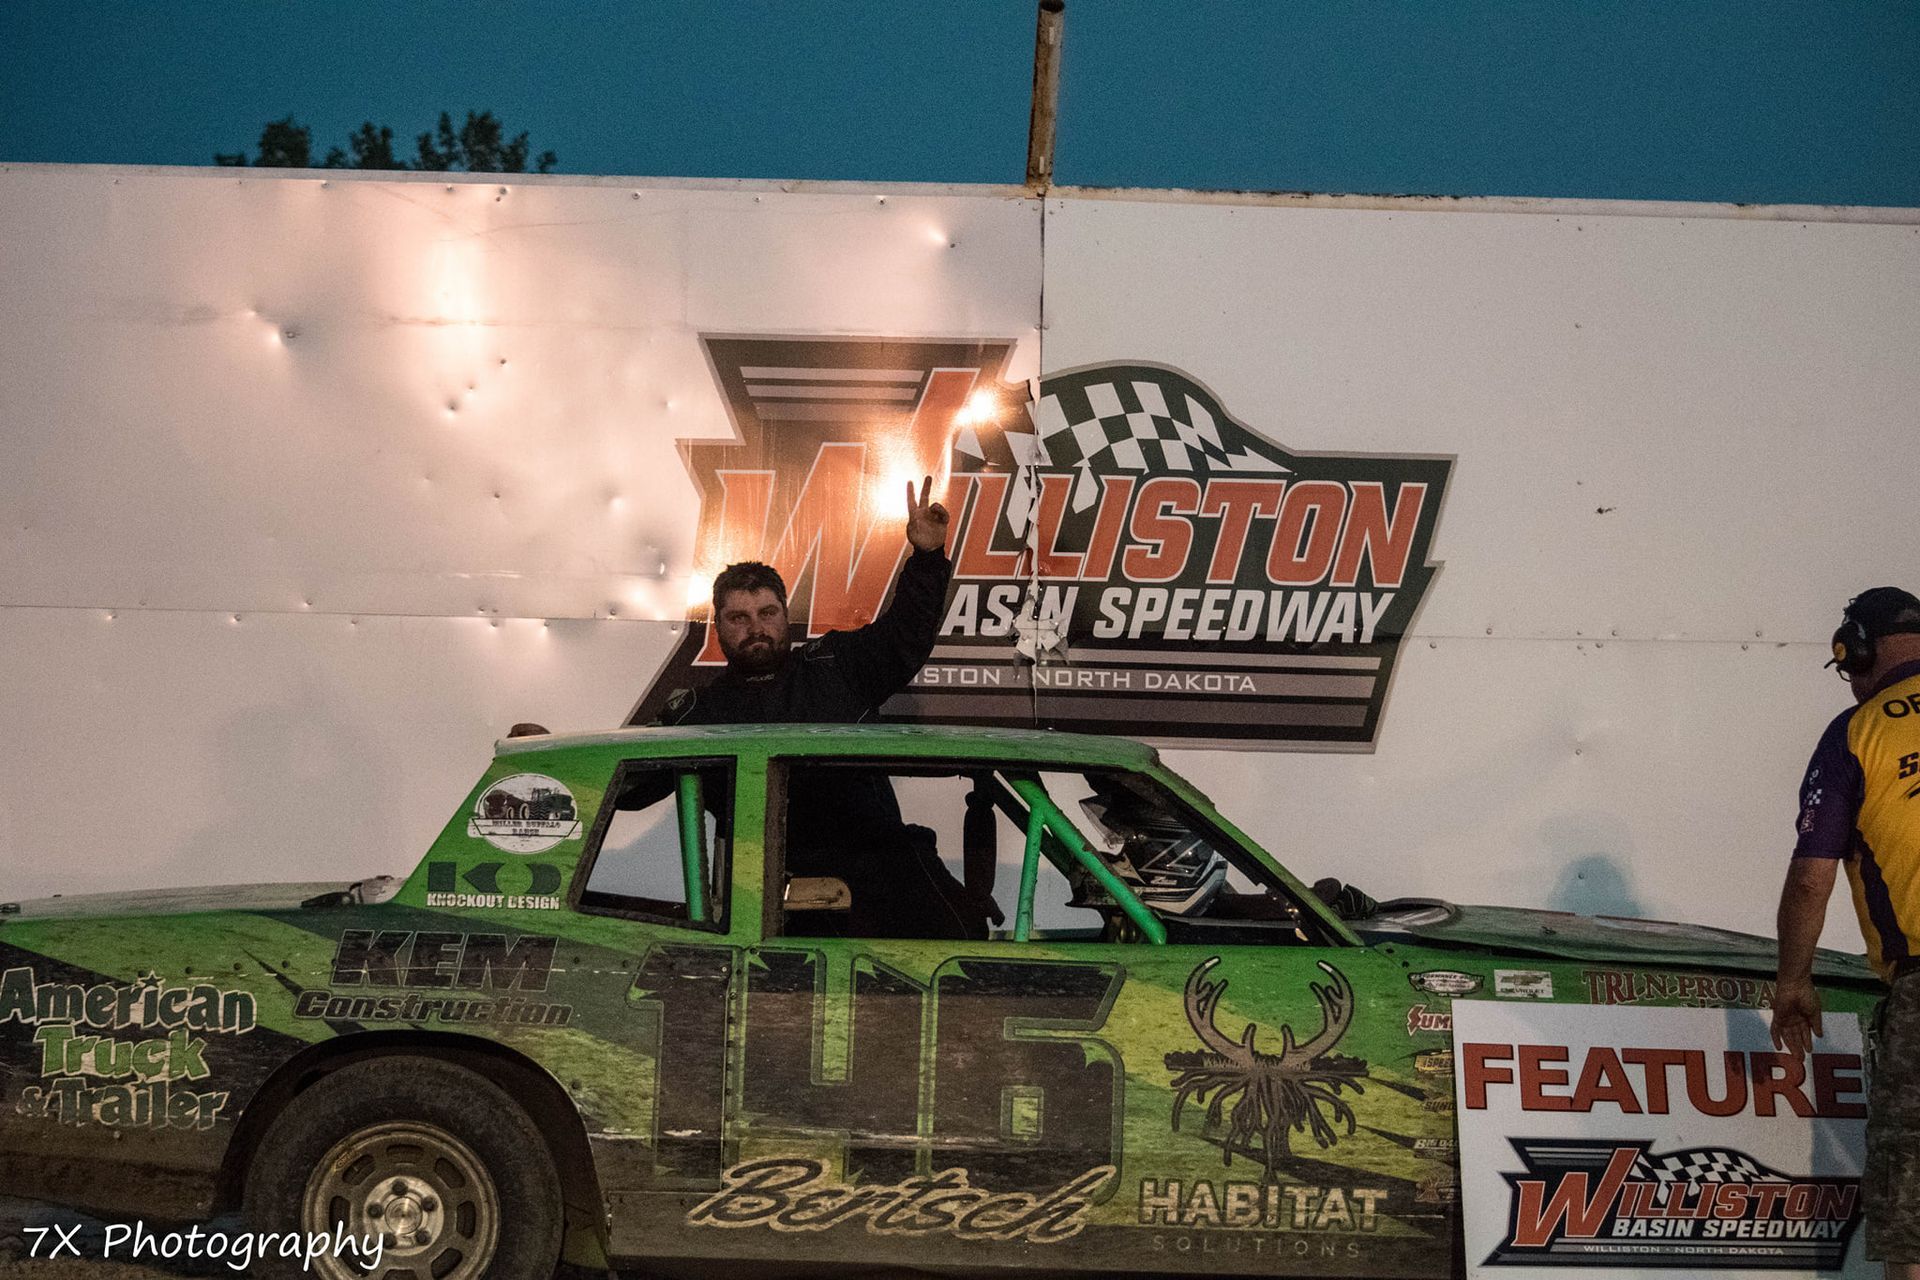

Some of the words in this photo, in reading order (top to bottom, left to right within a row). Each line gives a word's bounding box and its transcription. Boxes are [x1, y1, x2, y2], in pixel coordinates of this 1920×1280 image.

[938, 583, 1081, 638] ASIN
[1093, 586, 1396, 644] SPEEDWAY
[1034, 670, 1131, 689] NORTH
[1145, 673, 1256, 692] DAKOTA
[427, 893, 505, 908] KNOCKOUT
[507, 895, 561, 910] DESIGN
[330, 928, 559, 993] KEM
[0, 966, 257, 1035] American
[295, 989, 574, 1027] Construction
[1406, 1004, 1453, 1037] SUM
[32, 1023, 211, 1081] Truck
[1463, 1042, 1868, 1119] FEATURE
[687, 1156, 1117, 1243] Bertsch
[1138, 1178, 1389, 1232] HABITAT
[1510, 1147, 1859, 1247] WILLISTON
[1154, 1234, 1360, 1258] SOLUTIONS
[1583, 1245, 1661, 1254] WILLISTON
[1674, 1246, 1723, 1254] NORTH
[1729, 1246, 1784, 1256] DAKOTA
[1611, 1217, 1696, 1238] BASIN
[1702, 1218, 1847, 1239] SPEEDWAY
